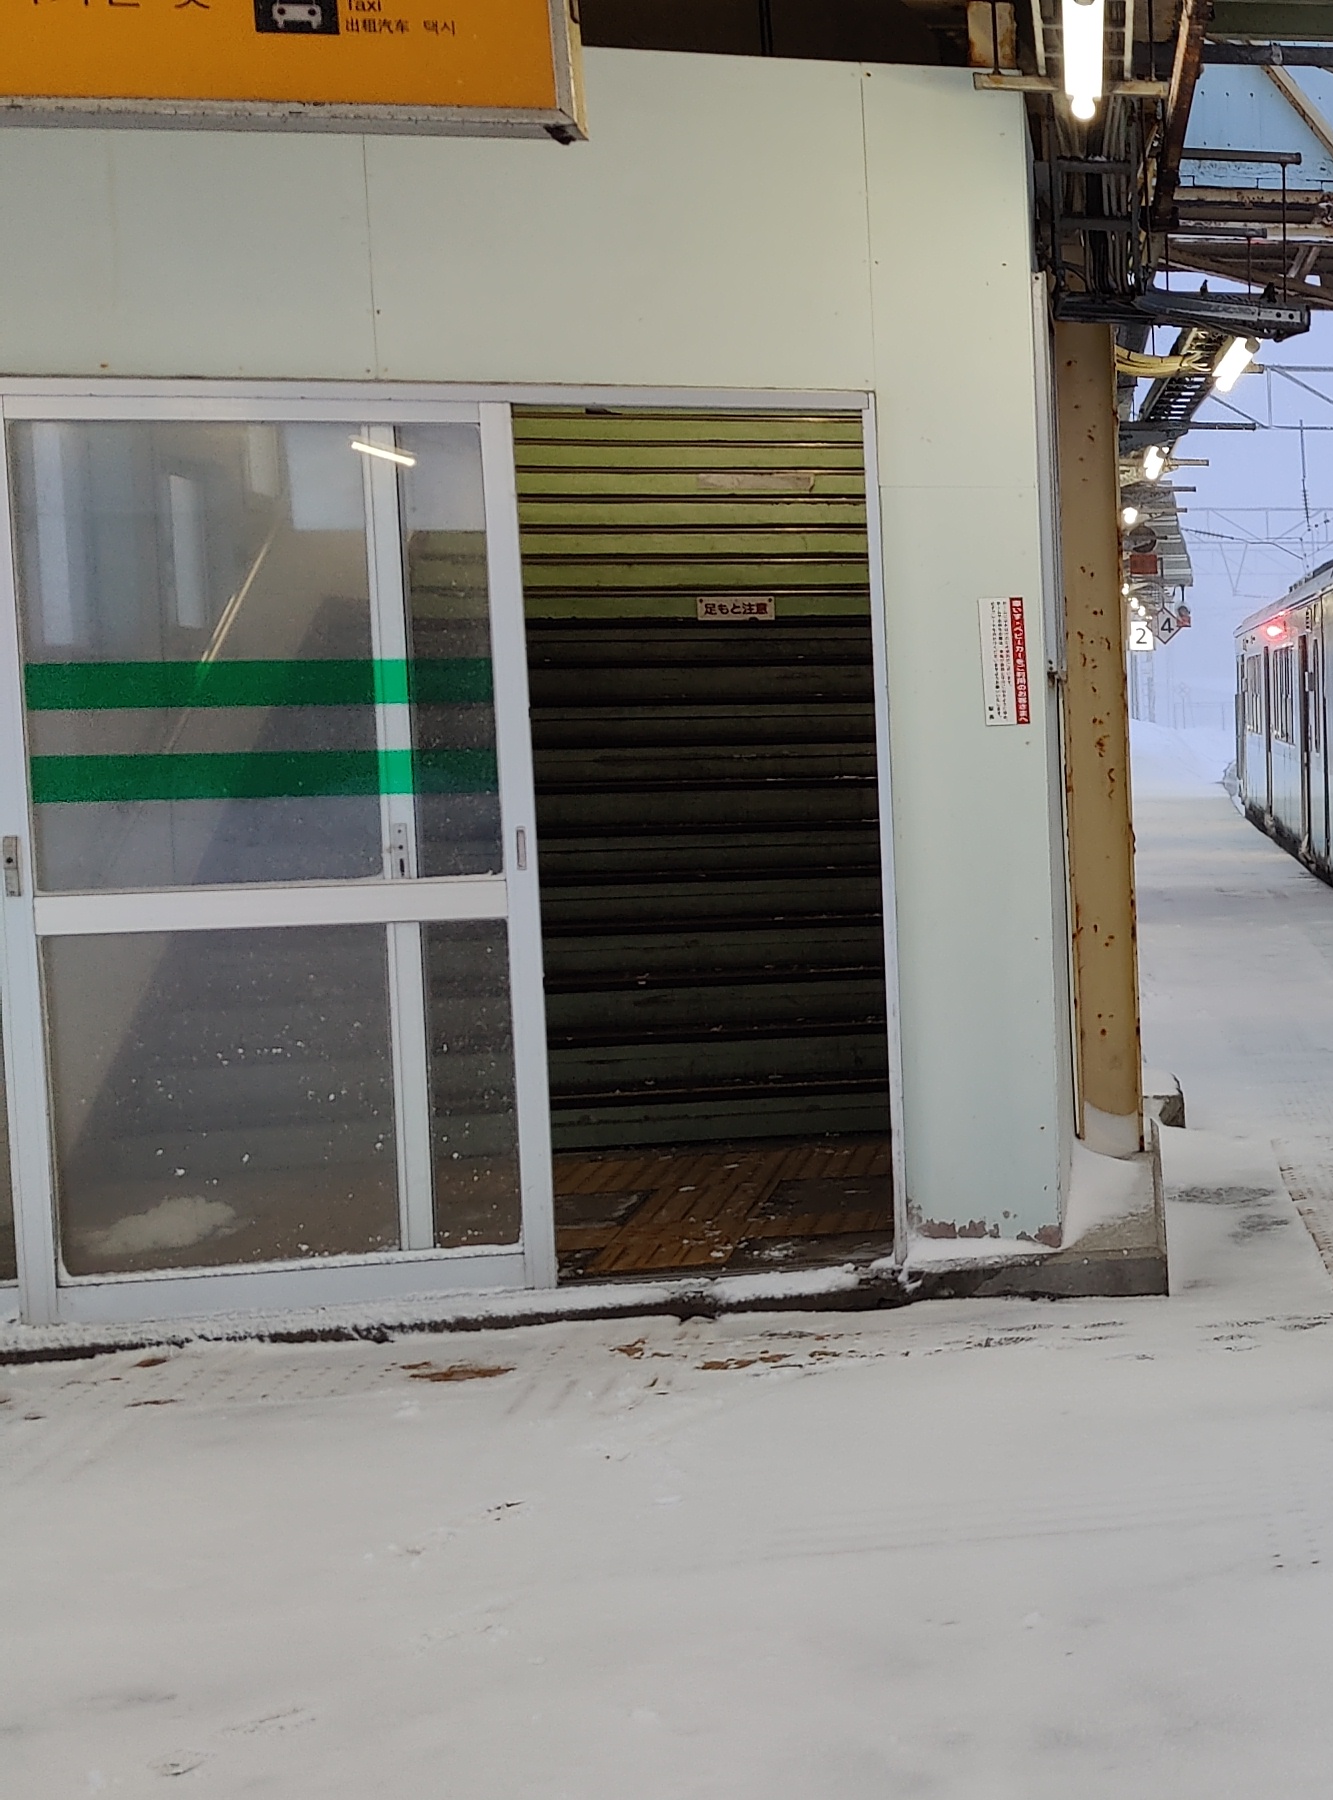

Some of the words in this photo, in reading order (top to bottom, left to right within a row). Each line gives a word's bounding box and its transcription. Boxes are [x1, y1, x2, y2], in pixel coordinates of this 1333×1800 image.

[423, 19, 456, 37] 택시
[704, 602, 768, 615] 足もと注意
[1160, 617, 1175, 634] 4
[1135, 627, 1148, 644] 2
